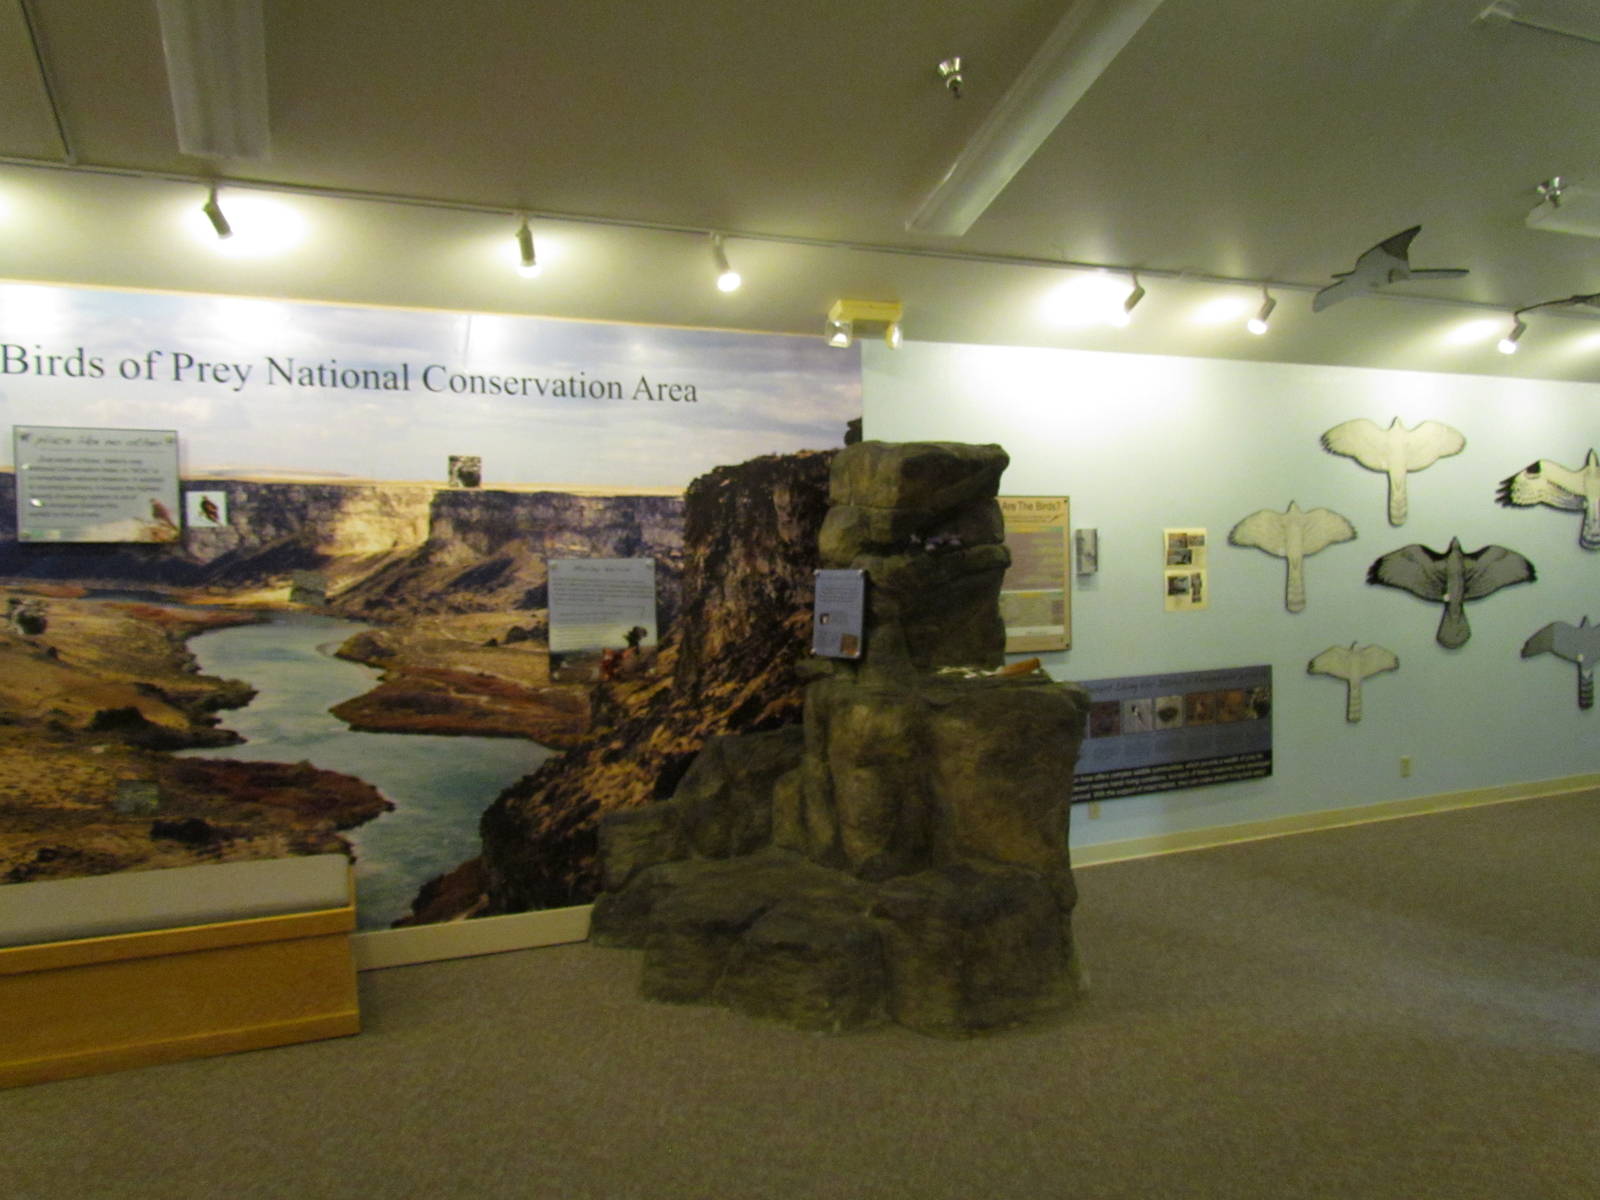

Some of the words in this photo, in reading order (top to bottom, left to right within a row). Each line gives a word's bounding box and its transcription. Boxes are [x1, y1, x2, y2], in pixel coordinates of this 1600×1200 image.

[0, 344, 105, 379] Birds
[119, 350, 163, 381] of
[172, 352, 253, 392] Prey
[266, 356, 410, 392] National
[422, 364, 624, 401] Conservation
[632, 375, 699, 403] Area
